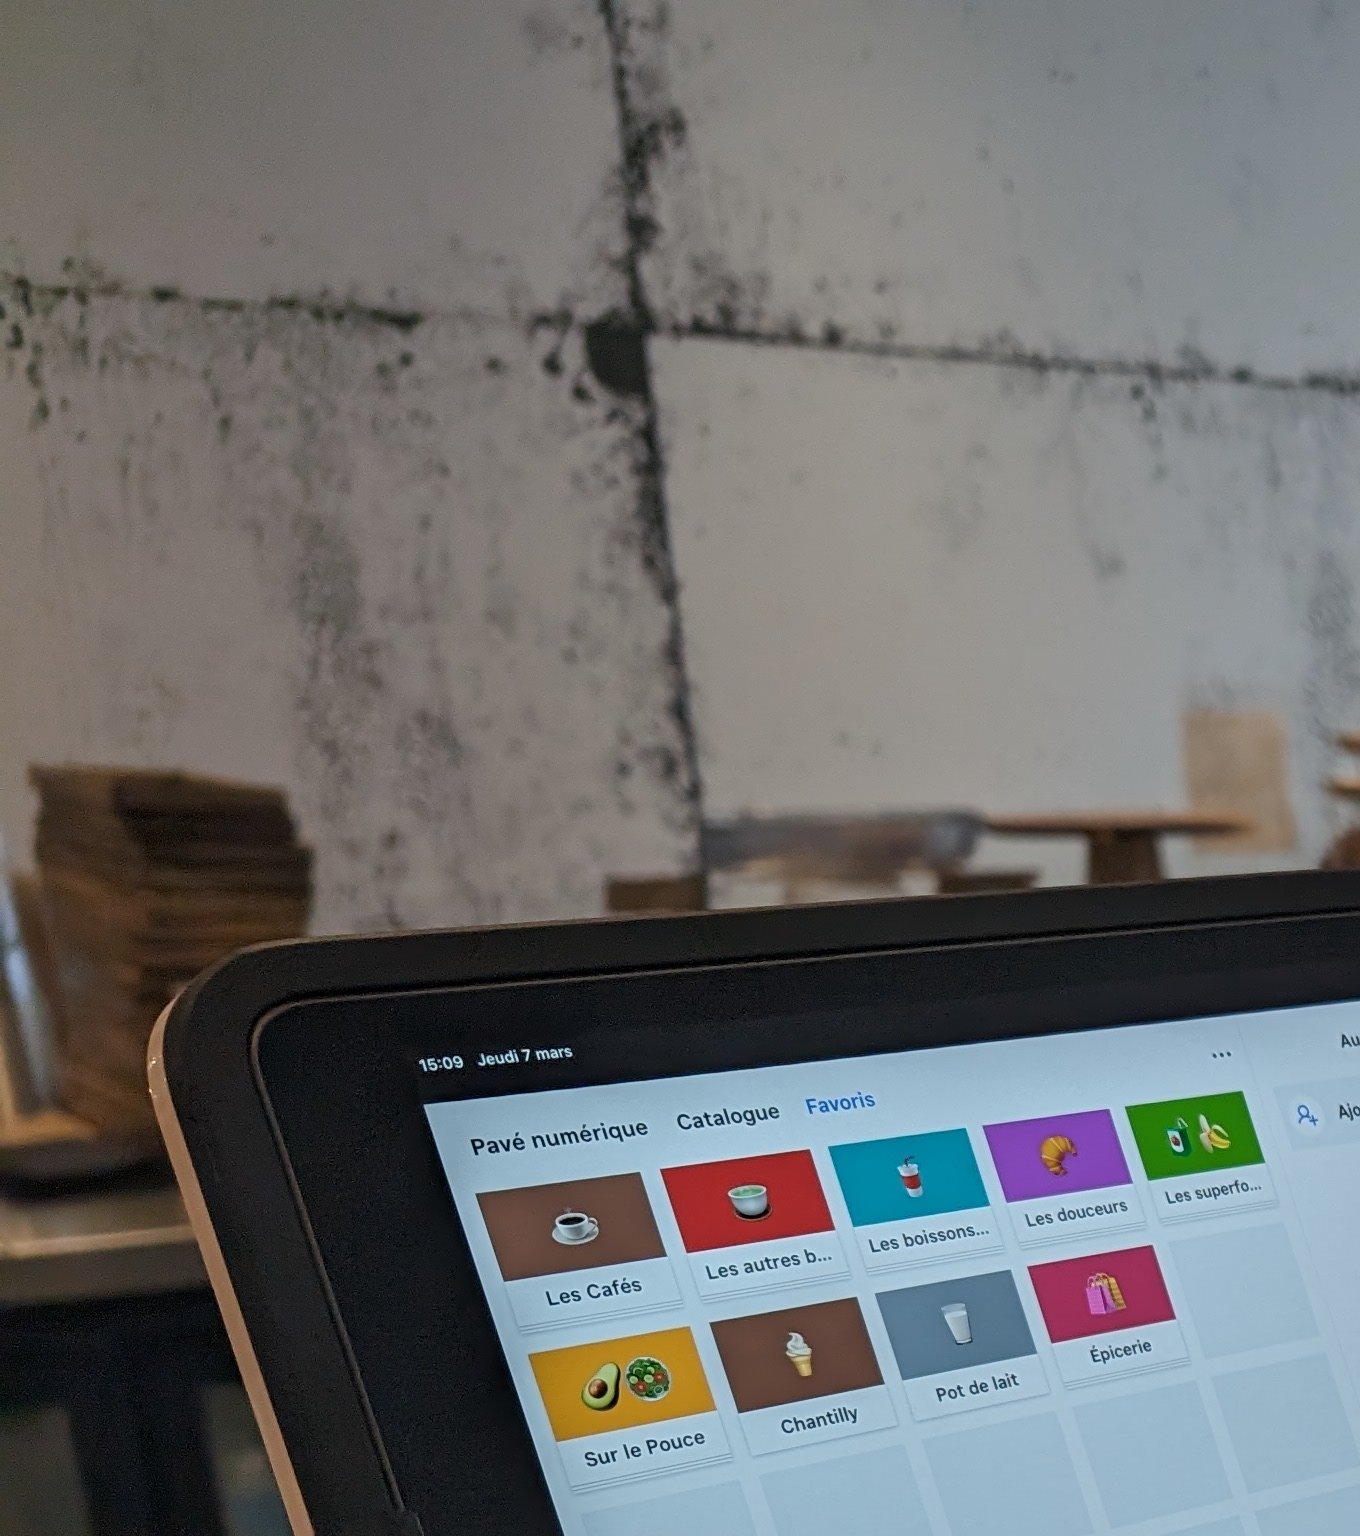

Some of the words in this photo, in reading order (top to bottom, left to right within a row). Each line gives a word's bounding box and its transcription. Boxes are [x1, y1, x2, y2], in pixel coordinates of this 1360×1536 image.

[418, 1054, 464, 1073] 15:09
[476, 1049, 519, 1068] Jeudi
[521, 1049, 531, 1062] 7
[535, 1045, 573, 1061] mars
[676, 1103, 781, 1131] Catalogue
[805, 1091, 876, 1115] Favoris
[469, 1131, 525, 1156] Pavé
[530, 1120, 649, 1149] numérique
[1164, 1190, 1192, 1205] Les
[1024, 1211, 1054, 1228] Les
[1057, 1198, 1129, 1223] douceurs
[867, 1236, 900, 1254] Les
[704, 1262, 739, 1280] Les
[743, 1252, 802, 1276] autres
[545, 1288, 582, 1307] Les
[586, 1276, 643, 1300] Cafés
[1089, 1339, 1152, 1364] Épicerie
[935, 1385, 966, 1403] Pot
[969, 1380, 989, 1397] de
[993, 1373, 1020, 1391] lait
[780, 1405, 858, 1435] Chantilly
[583, 1447, 619, 1468] Sur
[622, 1443, 642, 1459] le
[645, 1430, 706, 1455] Pouce
